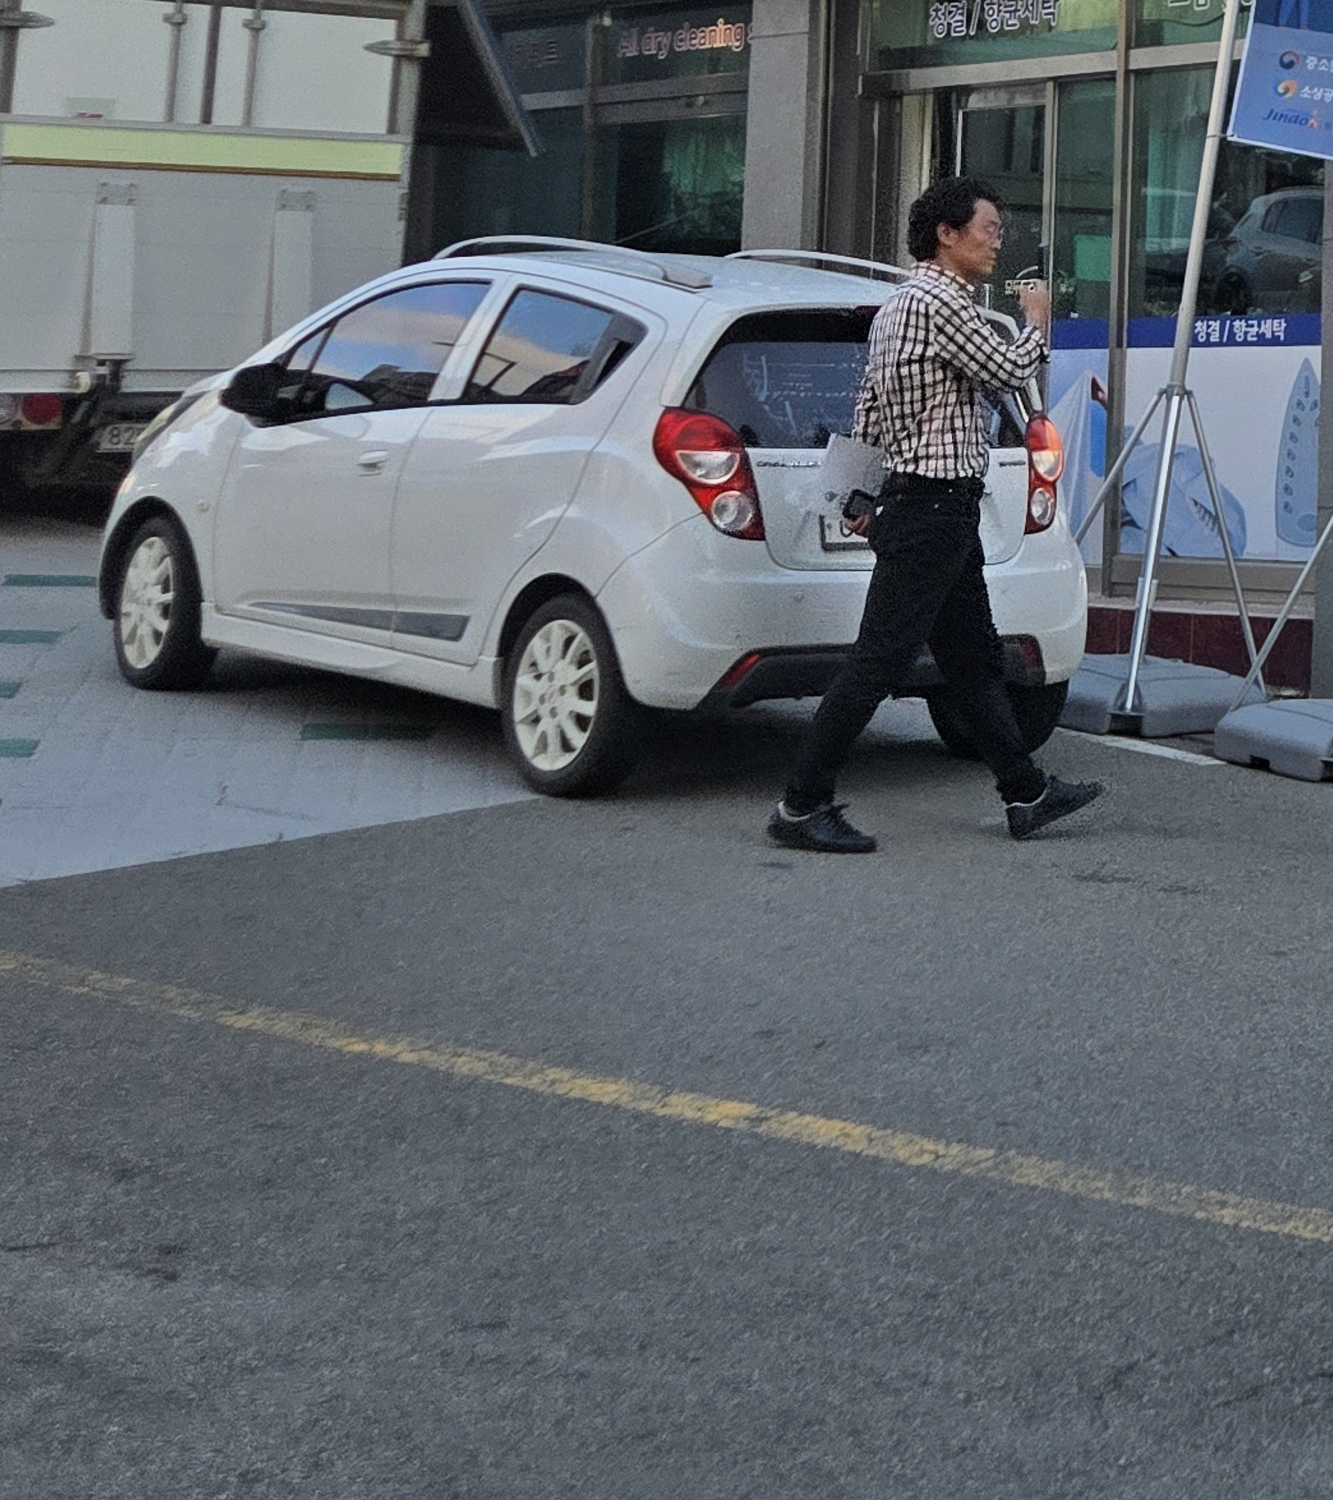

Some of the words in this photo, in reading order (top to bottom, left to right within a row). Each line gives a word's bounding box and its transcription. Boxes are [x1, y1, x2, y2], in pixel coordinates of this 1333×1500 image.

[929, 2, 967, 38] 청결
[641, 26, 671, 60] dry
[673, 17, 746, 52] cleaning
[1195, 319, 1220, 342] 청결
[108, 426, 146, 447] 82
